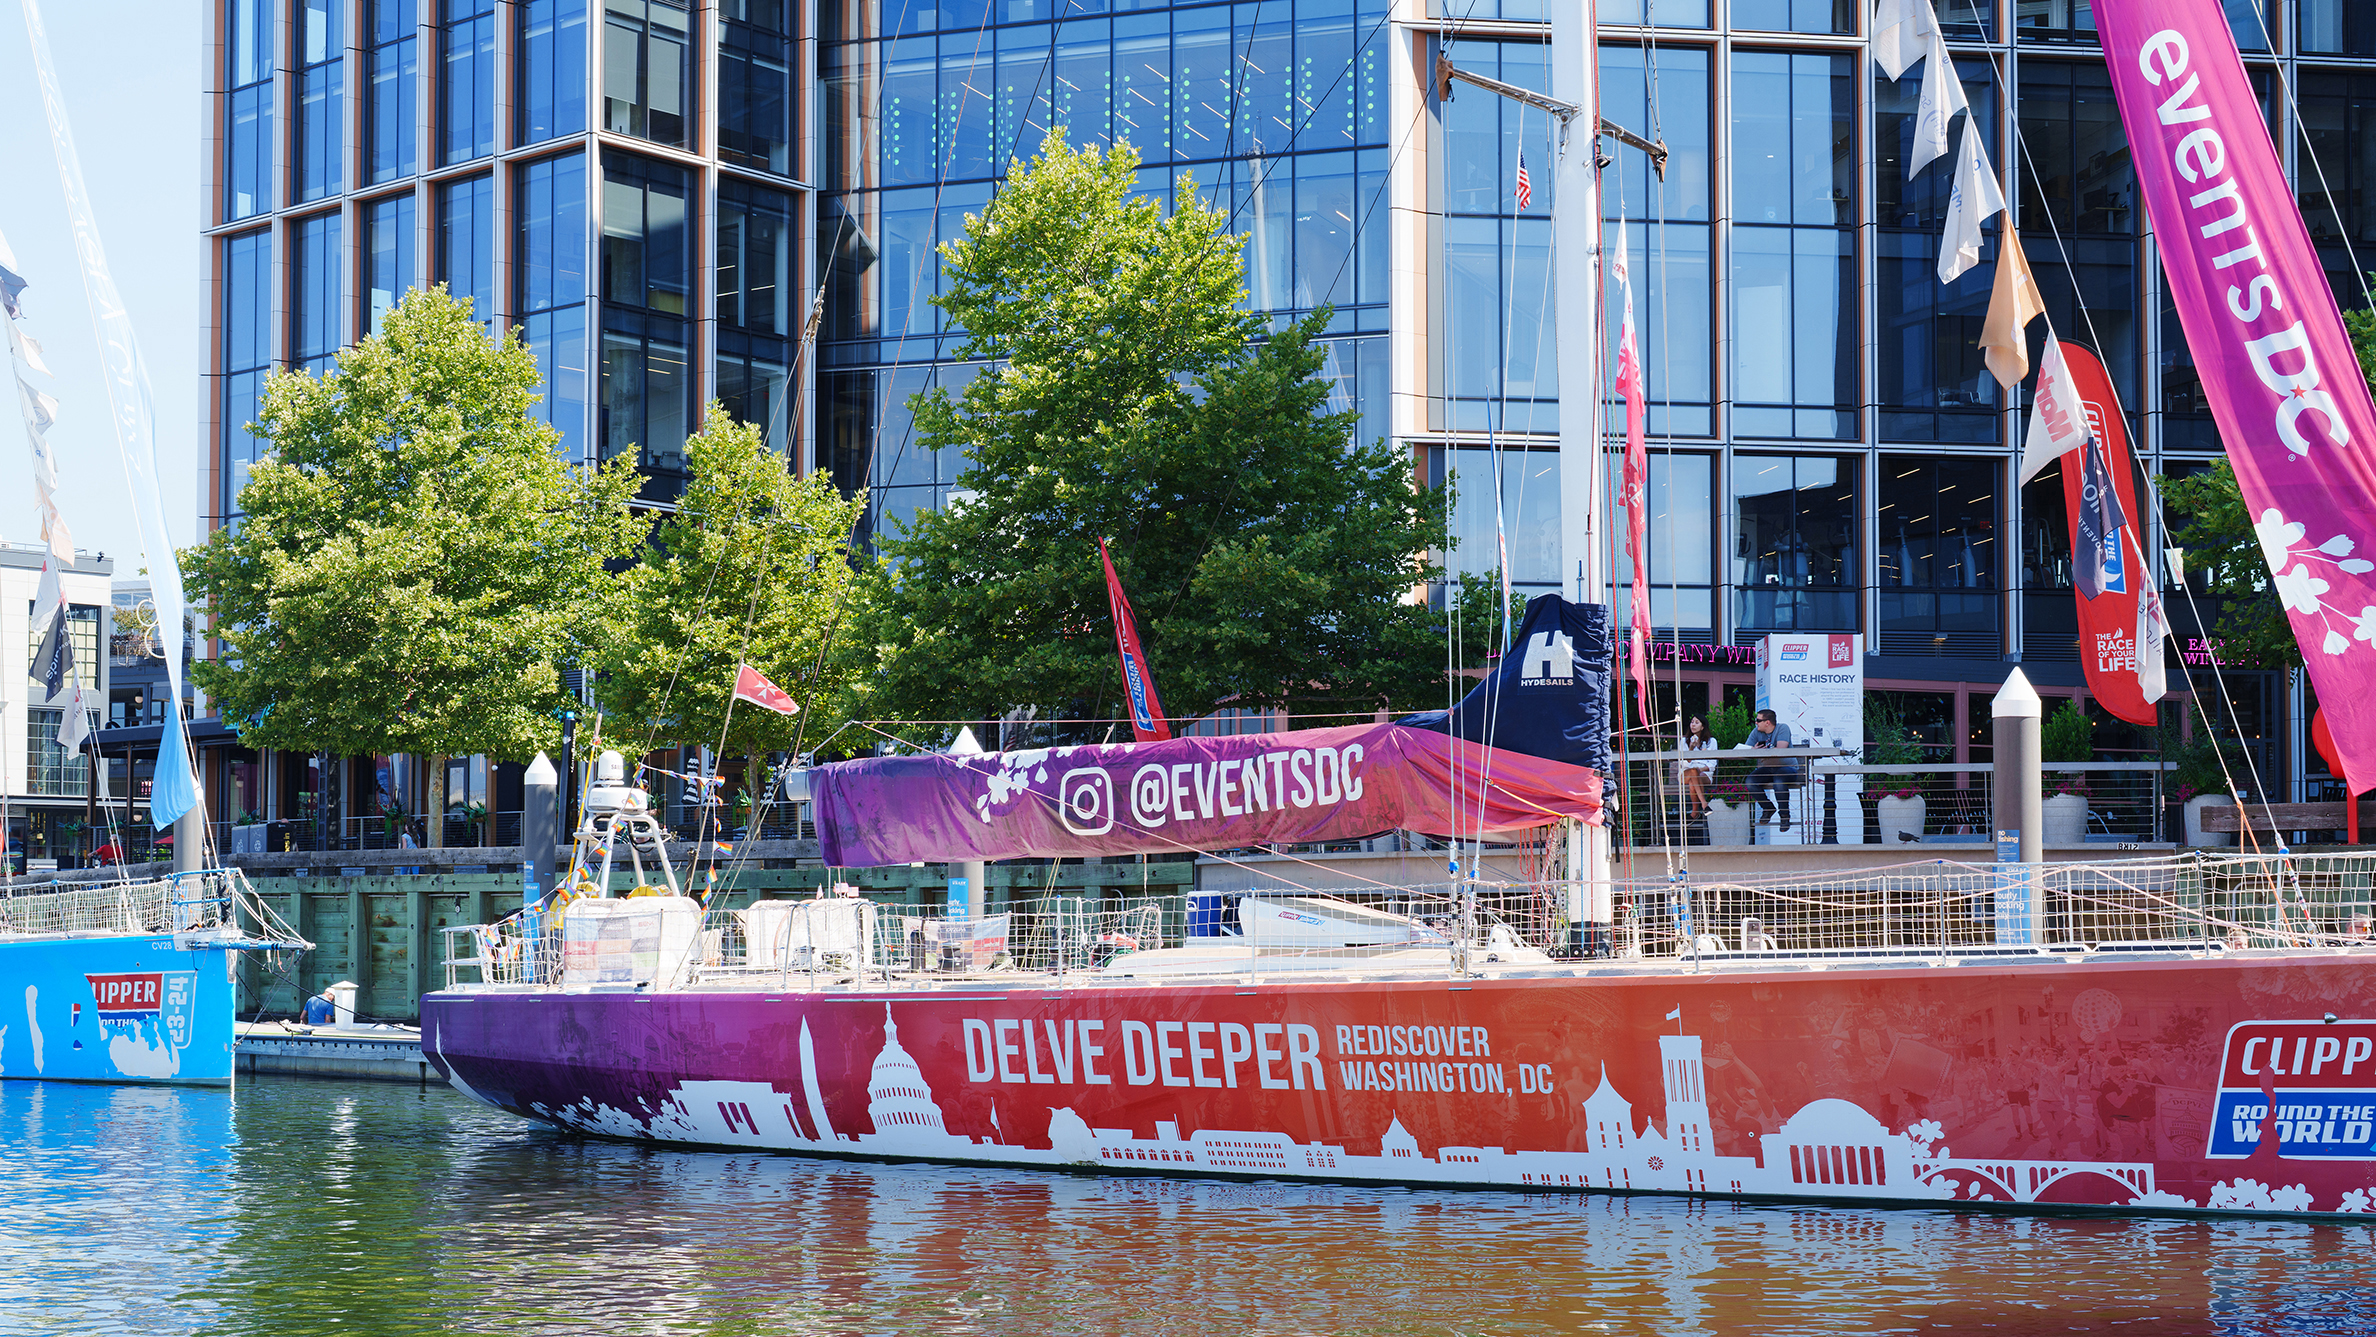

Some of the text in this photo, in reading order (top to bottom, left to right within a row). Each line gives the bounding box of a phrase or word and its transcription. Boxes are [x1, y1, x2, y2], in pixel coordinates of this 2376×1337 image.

[2097, 639, 2134, 651] RACE
[2098, 657, 2135, 672] LIFE
[1779, 674, 1856, 683] RACE HISTORY
[1131, 743, 1364, 828] @EVENTSDC
[152, 941, 173, 950] CV28
[1336, 1025, 1490, 1057] REDISCOVER
[962, 1018, 1326, 1090] DELVE DEEPER
[2242, 1037, 2376, 1075] CLIPP
[1339, 1061, 1554, 1097] WASHINGTON, DC
[2327, 1105, 2376, 1120] THE
[2232, 1121, 2373, 1143] WORLD
